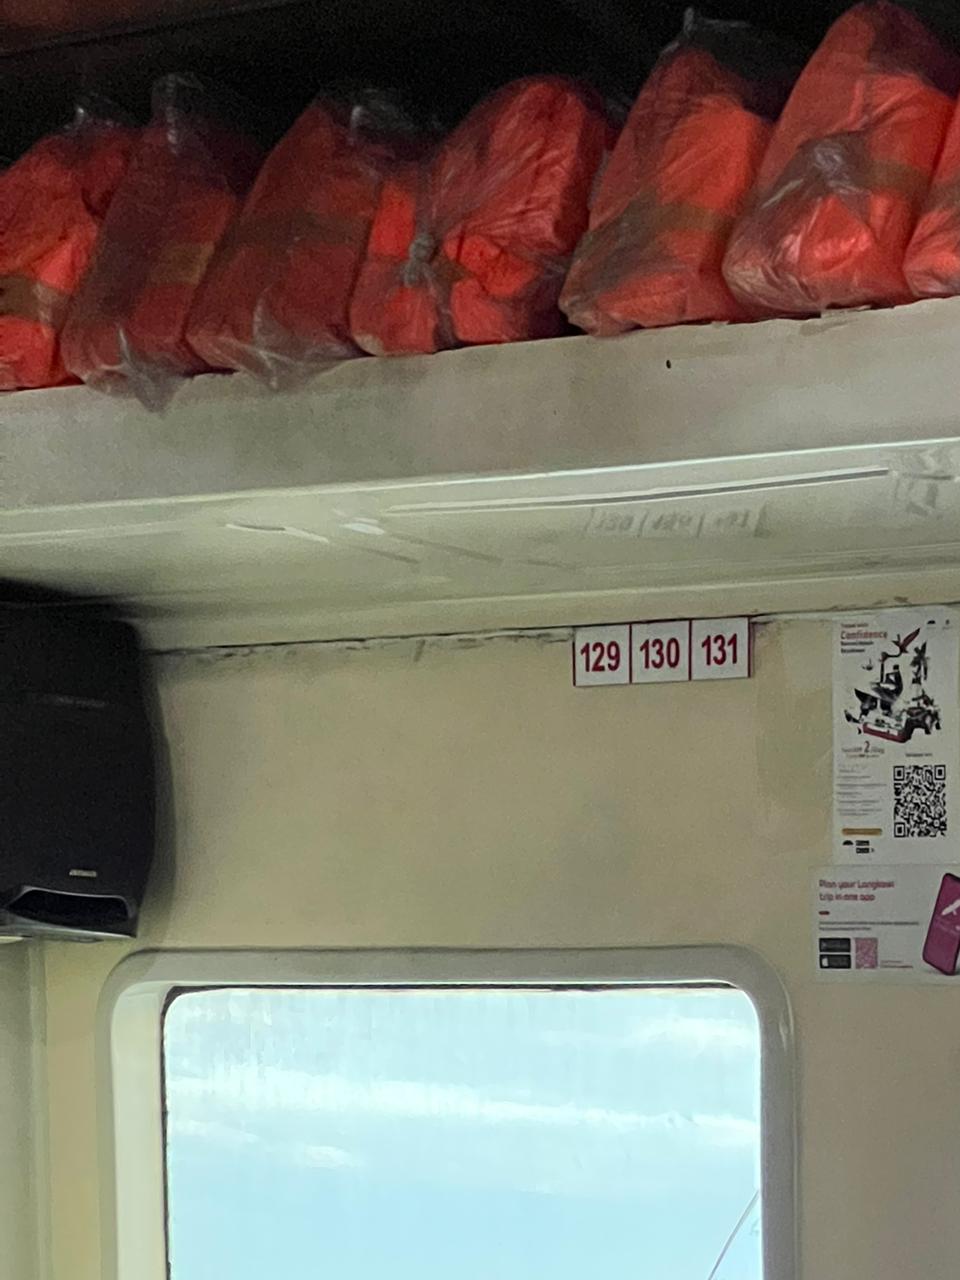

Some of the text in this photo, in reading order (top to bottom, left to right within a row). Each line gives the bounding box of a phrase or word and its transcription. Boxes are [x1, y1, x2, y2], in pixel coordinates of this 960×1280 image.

[580, 633, 738, 672] 129 130 131
